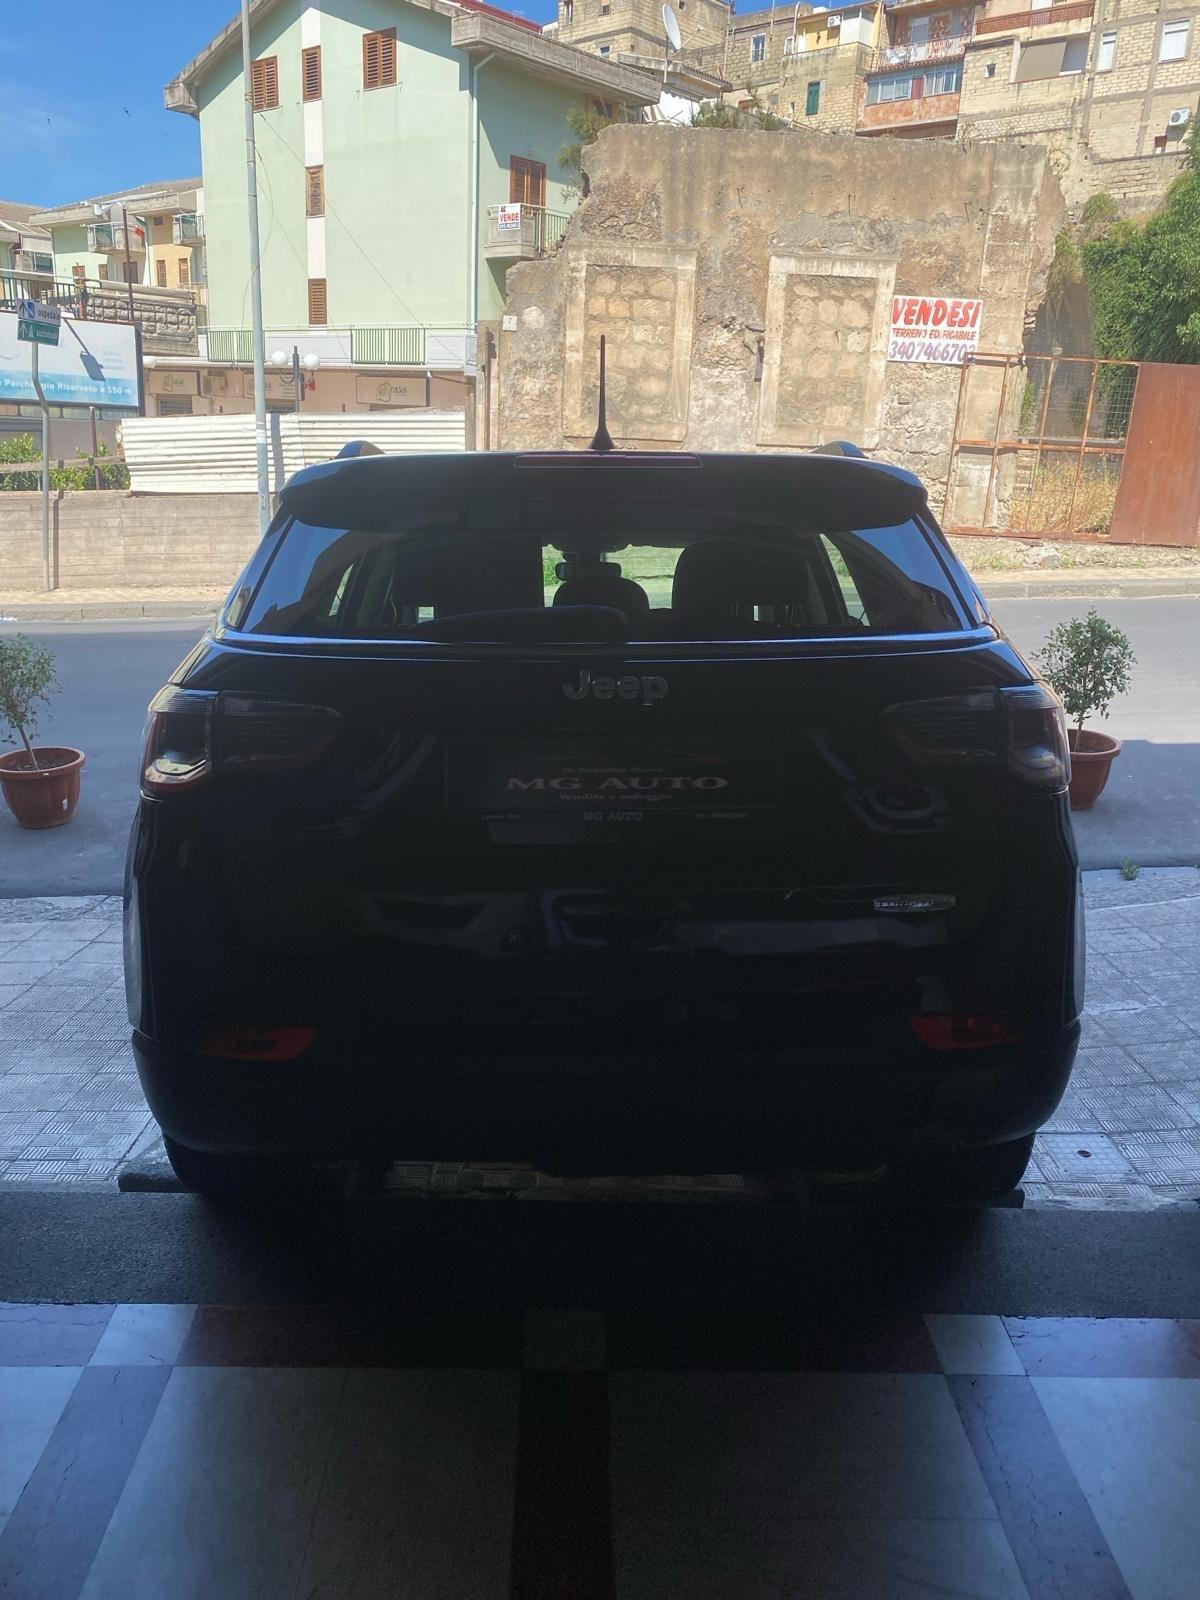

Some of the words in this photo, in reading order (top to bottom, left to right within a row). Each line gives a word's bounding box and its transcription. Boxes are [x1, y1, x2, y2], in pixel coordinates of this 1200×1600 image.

[500, 212, 520, 222] VENDE
[892, 298, 982, 328] VENDESI
[107, 386, 122, 395] 150
[563, 669, 671, 706] Jeep
[505, 777, 582, 791] MG
[599, 776, 729, 791] AUTO
[583, 811, 604, 822] MG
[607, 811, 644, 822] AUTO
